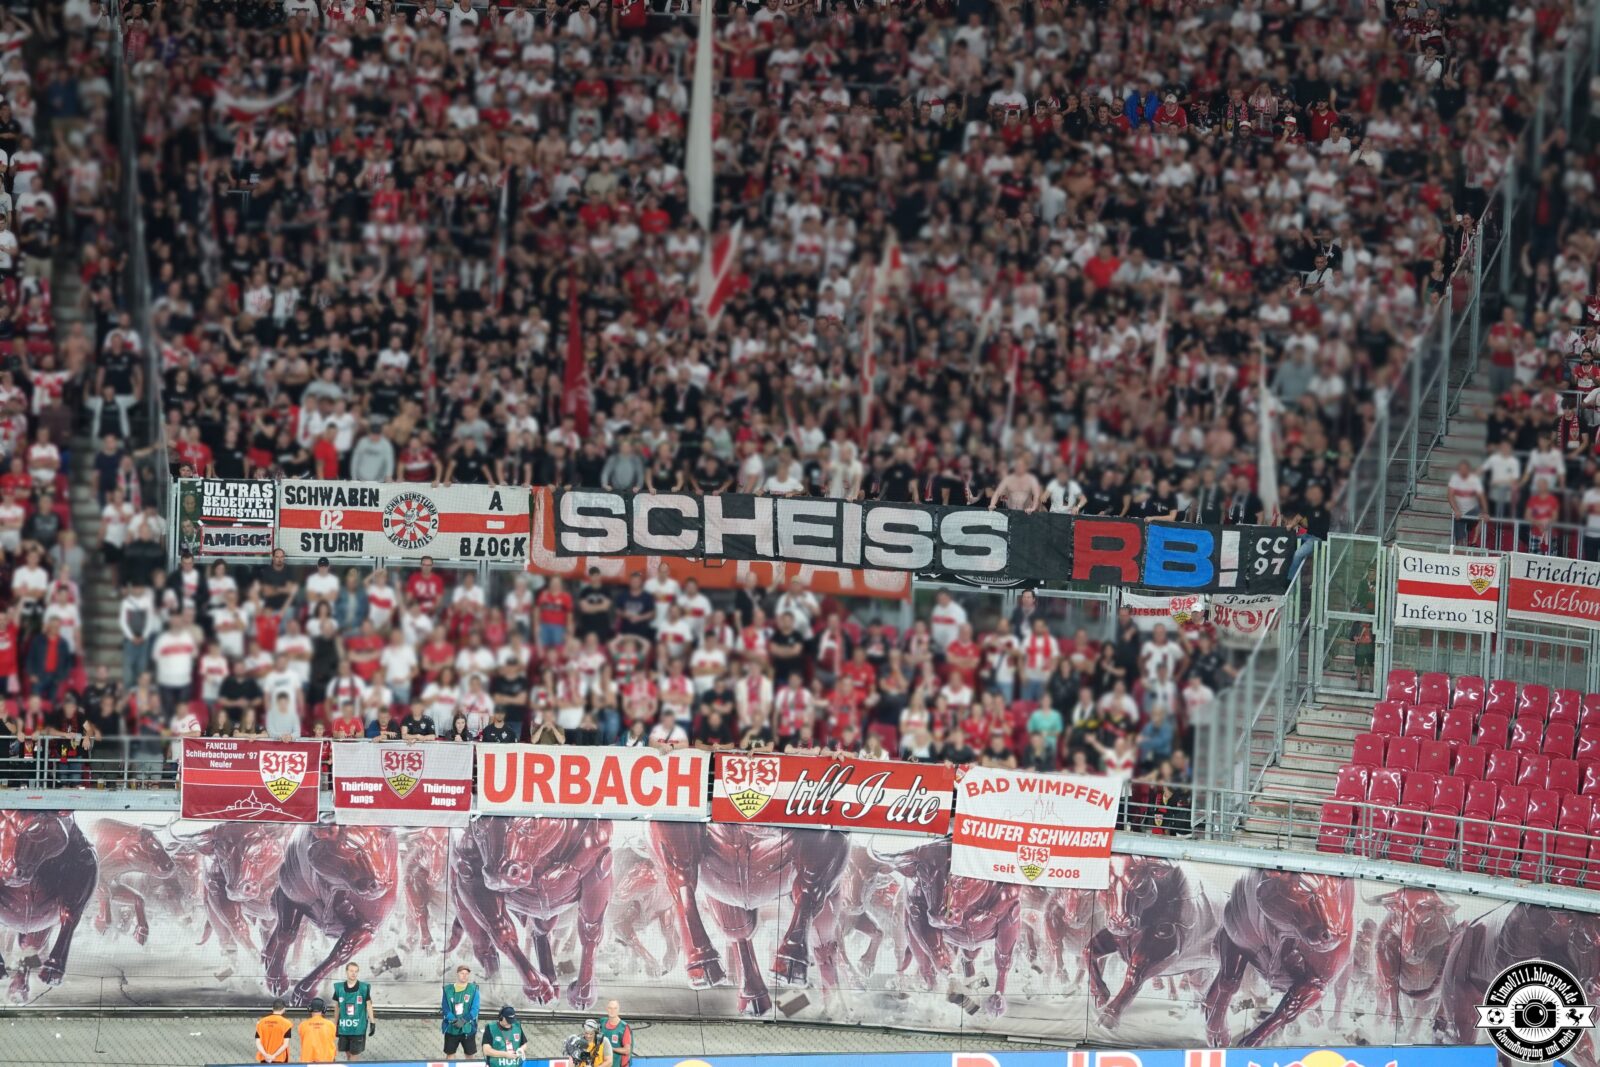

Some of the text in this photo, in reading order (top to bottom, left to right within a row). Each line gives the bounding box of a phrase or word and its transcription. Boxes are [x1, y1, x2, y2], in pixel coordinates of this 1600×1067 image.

[203, 481, 274, 498] ULTRAS
[284, 486, 380, 508] SCHWABEN
[203, 496, 274, 509] BEDEUTET
[384, 492, 437, 516] SCHWABENSTURM
[489, 491, 504, 511] A
[202, 507, 274, 519] WIDERSTAND
[320, 510, 344, 530] 02
[387, 533, 433, 549] STUTTGART
[560, 491, 1009, 572] SCHEISS
[301, 532, 364, 553] STURM
[459, 537, 527, 557] BLOCK
[1255, 536, 1288, 555] CC
[1072, 519, 1241, 588] RB!
[1254, 557, 1286, 576] 97
[1403, 556, 1460, 577] Glems
[1401, 602, 1494, 625] Inferno '18
[205, 742, 238, 751] FANCLUB
[261, 752, 307, 775] VfB
[384, 751, 423, 773] VfB
[483, 752, 703, 808] URBACH
[725, 758, 780, 787] VfB
[341, 781, 383, 793] Thüringer
[423, 783, 466, 795] Thüringer
[785, 763, 941, 825] till I die
[966, 777, 1114, 811] BAD WIMPFEN
[350, 794, 374, 804] Jungs
[431, 795, 457, 807] Jungs
[960, 819, 1109, 848] STAUFER SCHWABEN
[993, 864, 1081, 879] seit 2008
